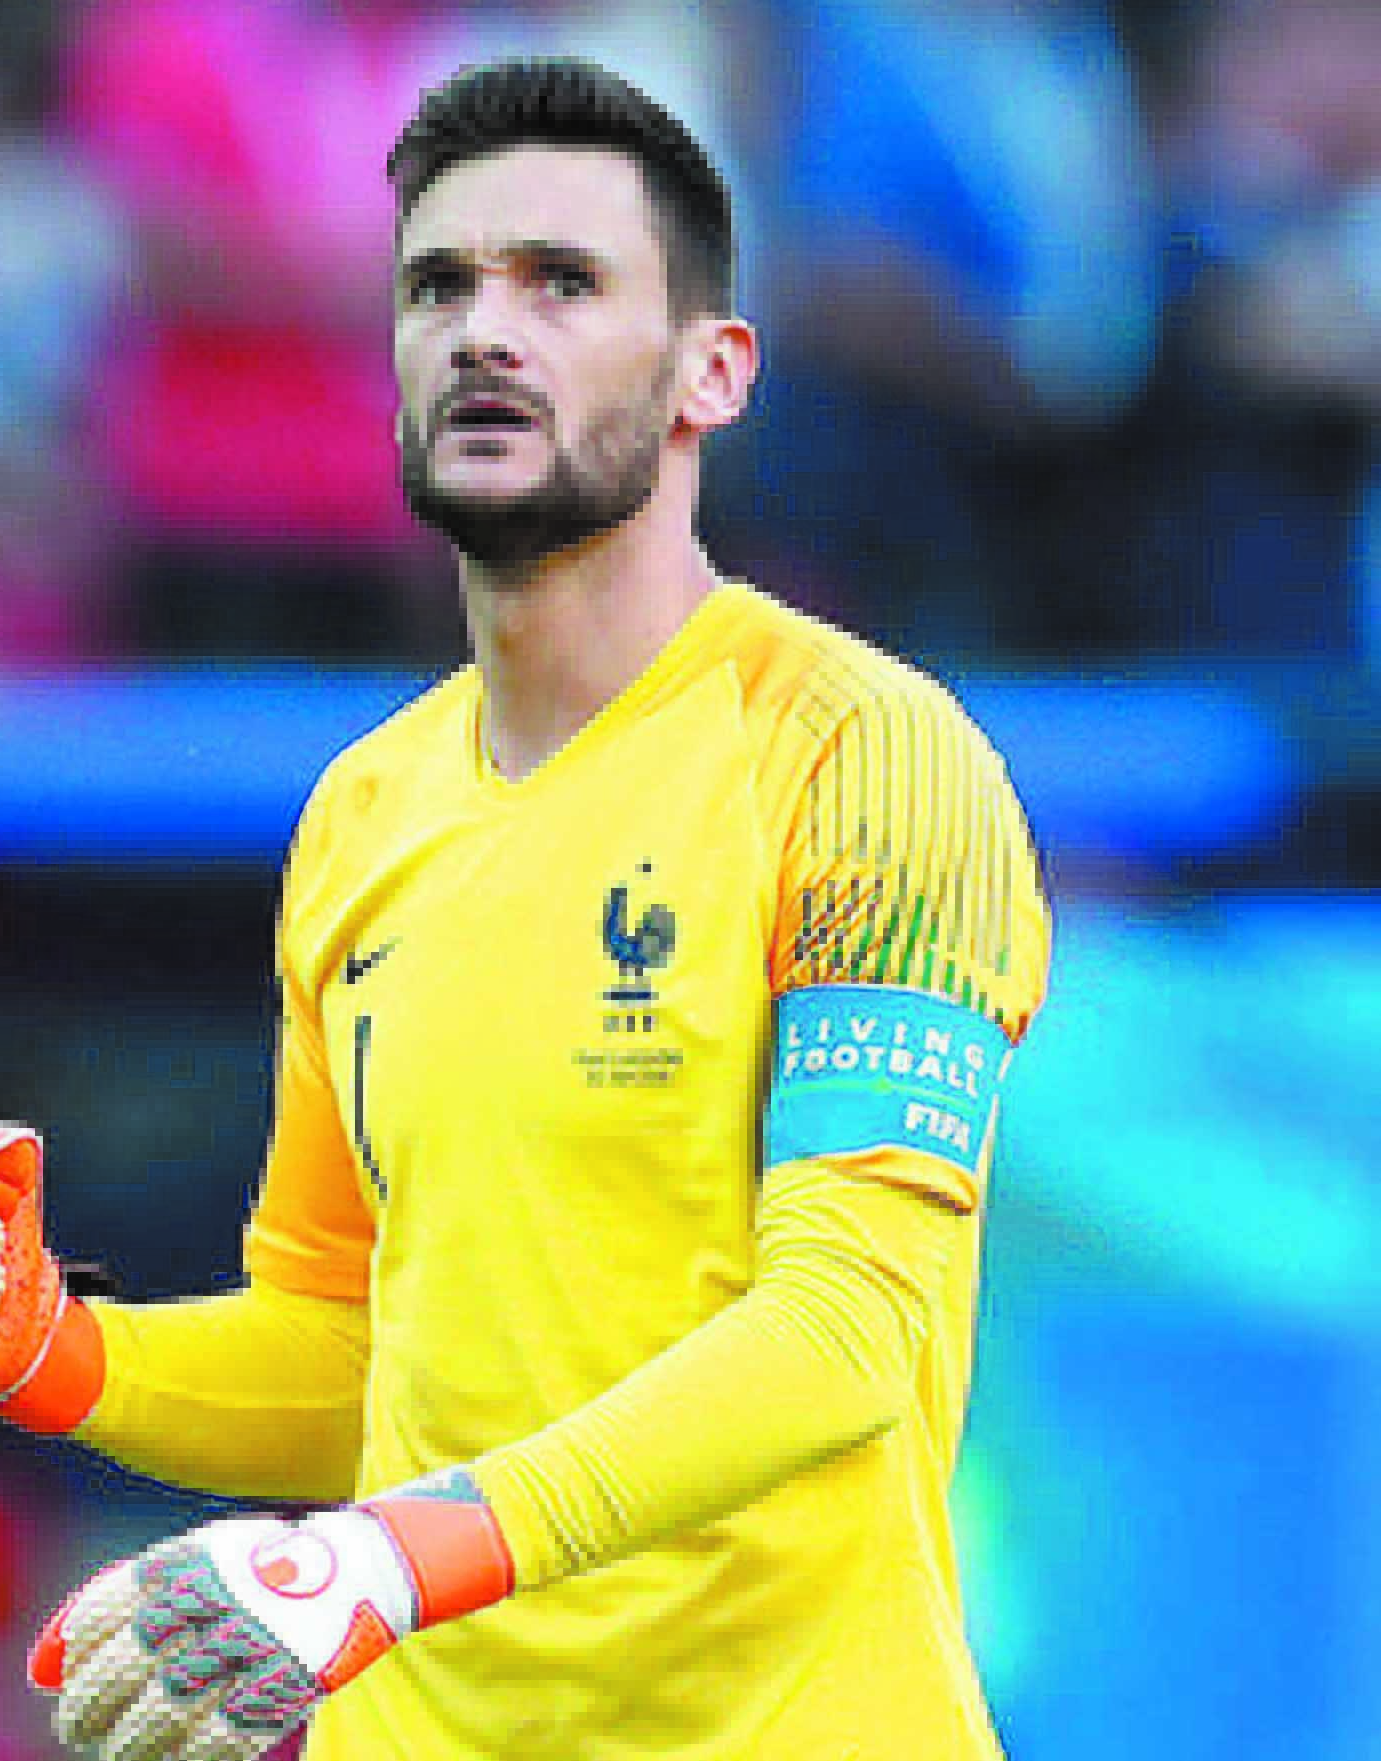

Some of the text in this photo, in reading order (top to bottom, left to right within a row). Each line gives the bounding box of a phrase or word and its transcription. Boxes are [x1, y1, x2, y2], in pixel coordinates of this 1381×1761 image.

[787, 1017, 985, 1070] LIVING
[784, 1045, 978, 1098] FOOTBALL
[905, 1101, 971, 1152] FIFA
